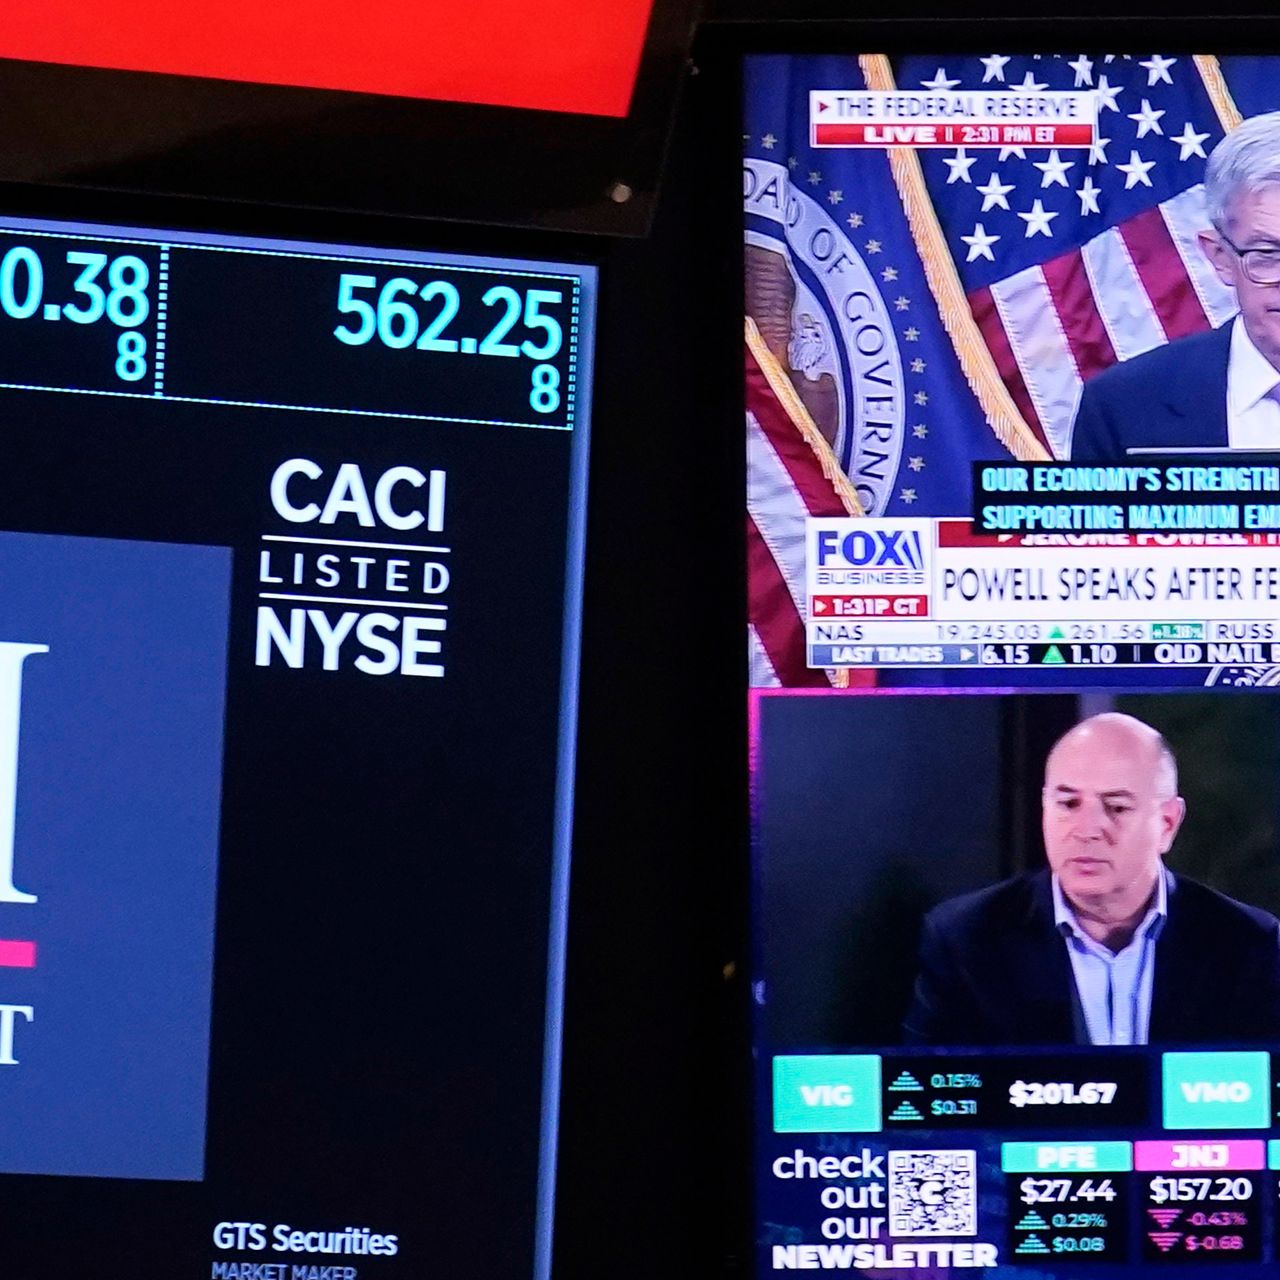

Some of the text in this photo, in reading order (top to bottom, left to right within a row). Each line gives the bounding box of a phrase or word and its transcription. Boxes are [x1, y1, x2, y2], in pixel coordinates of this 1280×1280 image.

[837, 97, 1078, 118] THE FEDERAL RESERVE
[334, 274, 562, 360] 562.25
[115, 332, 146, 381] 8
[529, 365, 560, 413] 8
[270, 458, 446, 532] CACI
[817, 531, 900, 566] FOX
[259, 551, 450, 594] LISTED
[944, 568, 1048, 601] POWELL
[1059, 568, 1156, 600] SPEAKS
[1168, 567, 1242, 601] AFTER
[256, 606, 446, 677] NYSE
[816, 625, 863, 640] NAS
[1217, 624, 1277, 639] RUSS
[773, 1149, 885, 1178] check
[821, 1182, 885, 1209] out
[1020, 1178, 1116, 1204] $27.44
[1150, 1177, 1252, 1204] $157.20
[213, 1222, 398, 1257] GTS Securities
[821, 1218, 885, 1239] our
[773, 1243, 998, 1269] NEWSLETTER
